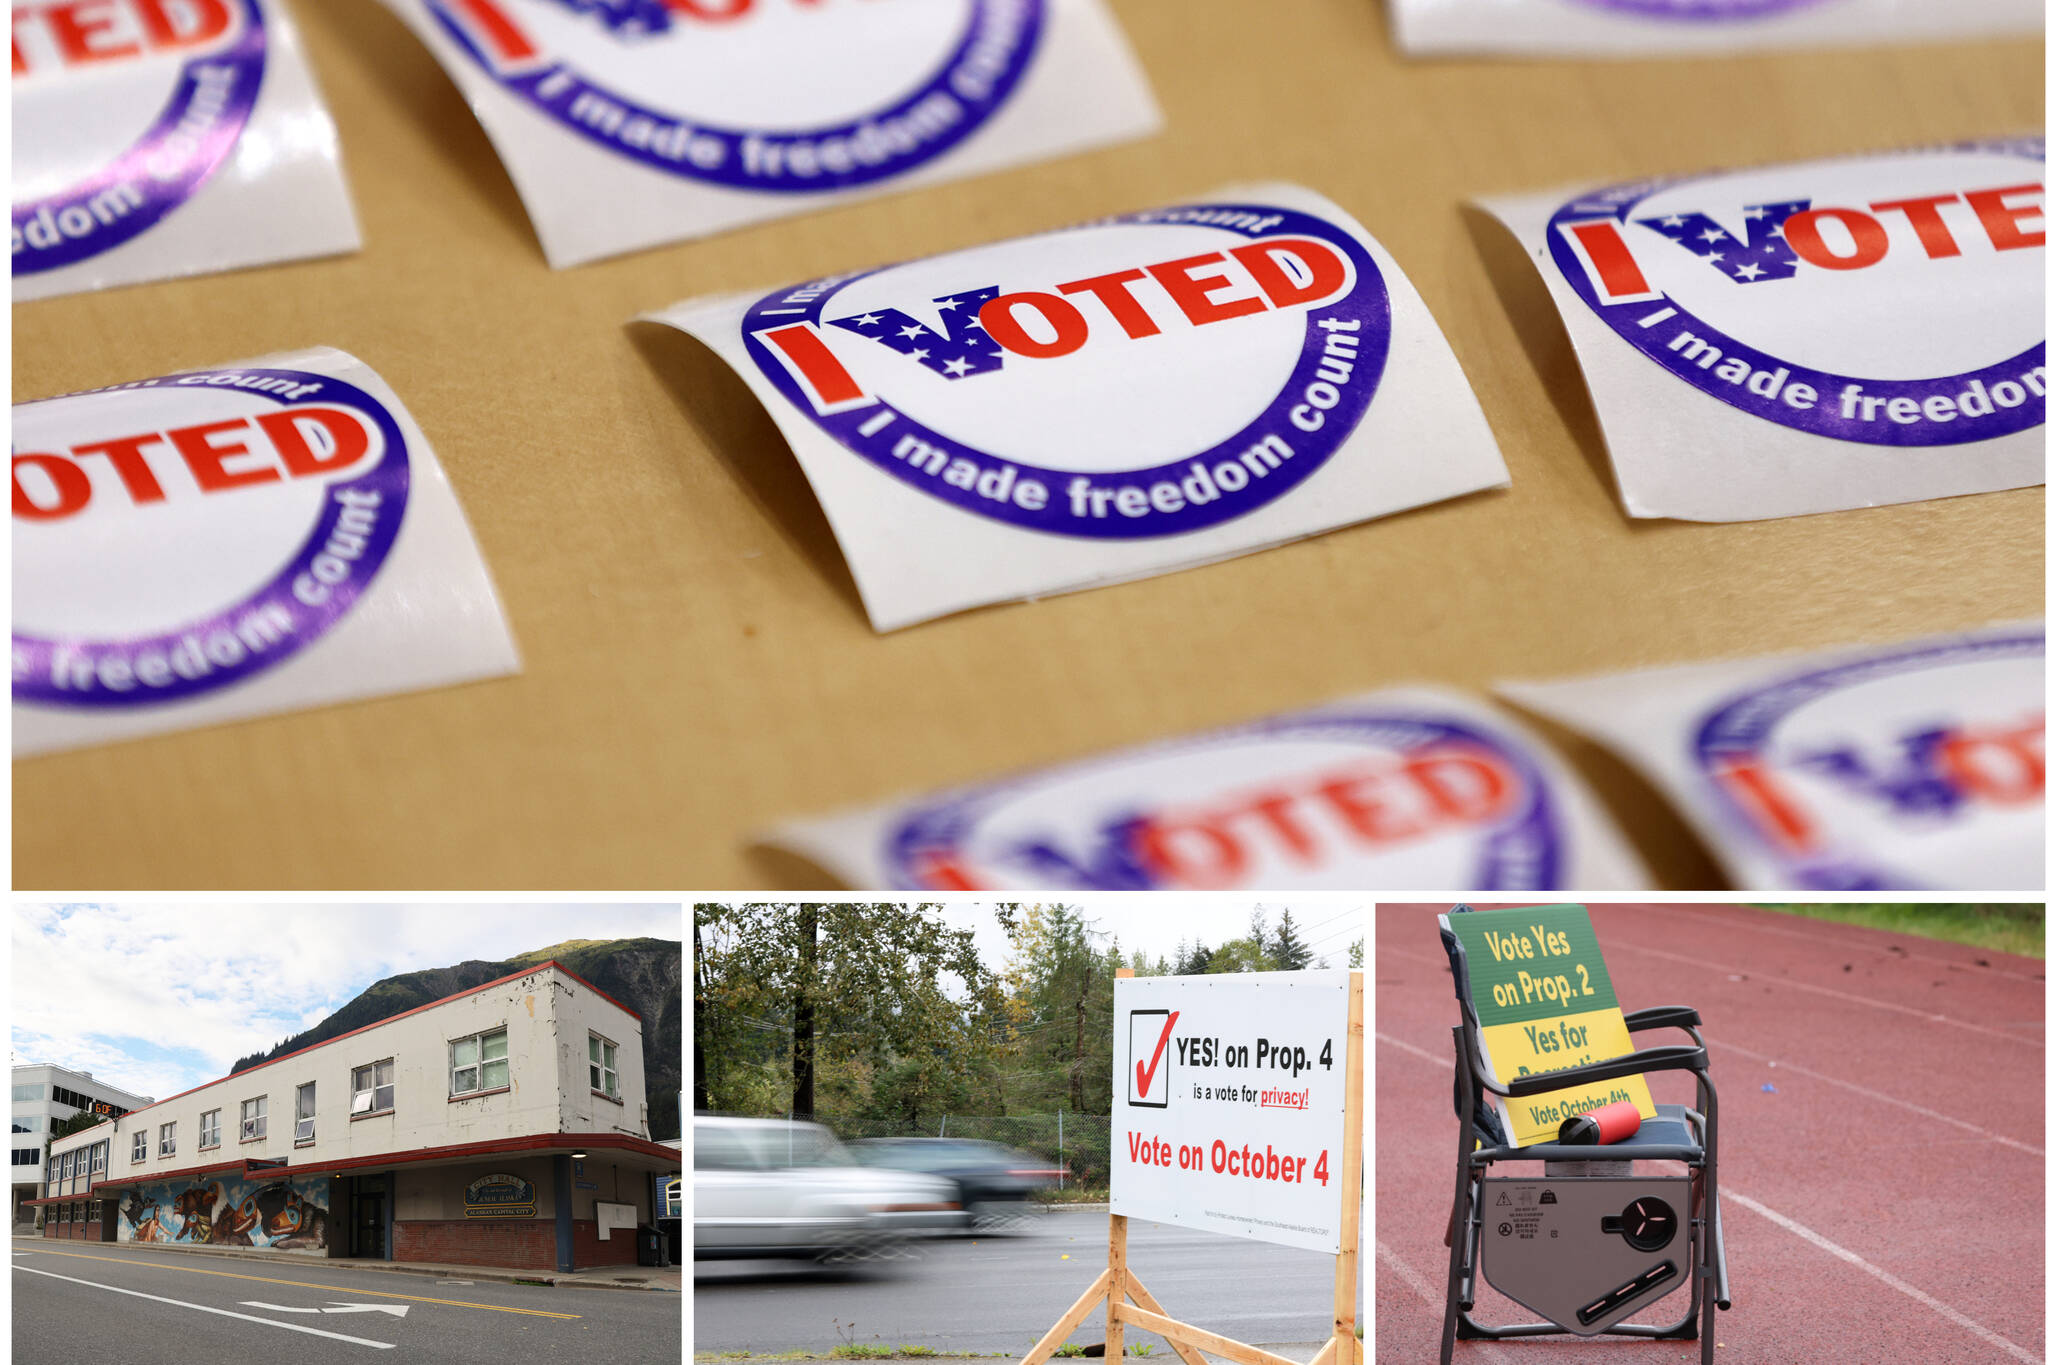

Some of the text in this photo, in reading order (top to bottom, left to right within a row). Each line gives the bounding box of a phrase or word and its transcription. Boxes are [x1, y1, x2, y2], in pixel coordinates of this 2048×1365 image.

[536, 70, 572, 98] I
[570, 91, 728, 170] made
[741, 89, 964, 177] freedom
[1570, 222, 1652, 298] I
[764, 238, 1347, 405] I VOTED
[1636, 306, 1678, 330] I
[1666, 330, 1819, 410] made
[177, 373, 324, 400] count
[856, 315, 1362, 518] I made freedom count
[50, 488, 383, 692] freedom count
[1484, 925, 1571, 962] Vote Yes
[1492, 963, 1595, 1008] on Prop. 2
[1176, 1037, 1333, 1078] YES! on Prop. 4
[1523, 1021, 1588, 1055] Yes for
[1193, 1082, 1309, 1110] is a vote for privacy!
[1529, 1104, 1560, 1126] Vote
[1128, 1131, 1329, 1187] Vote on October 4
